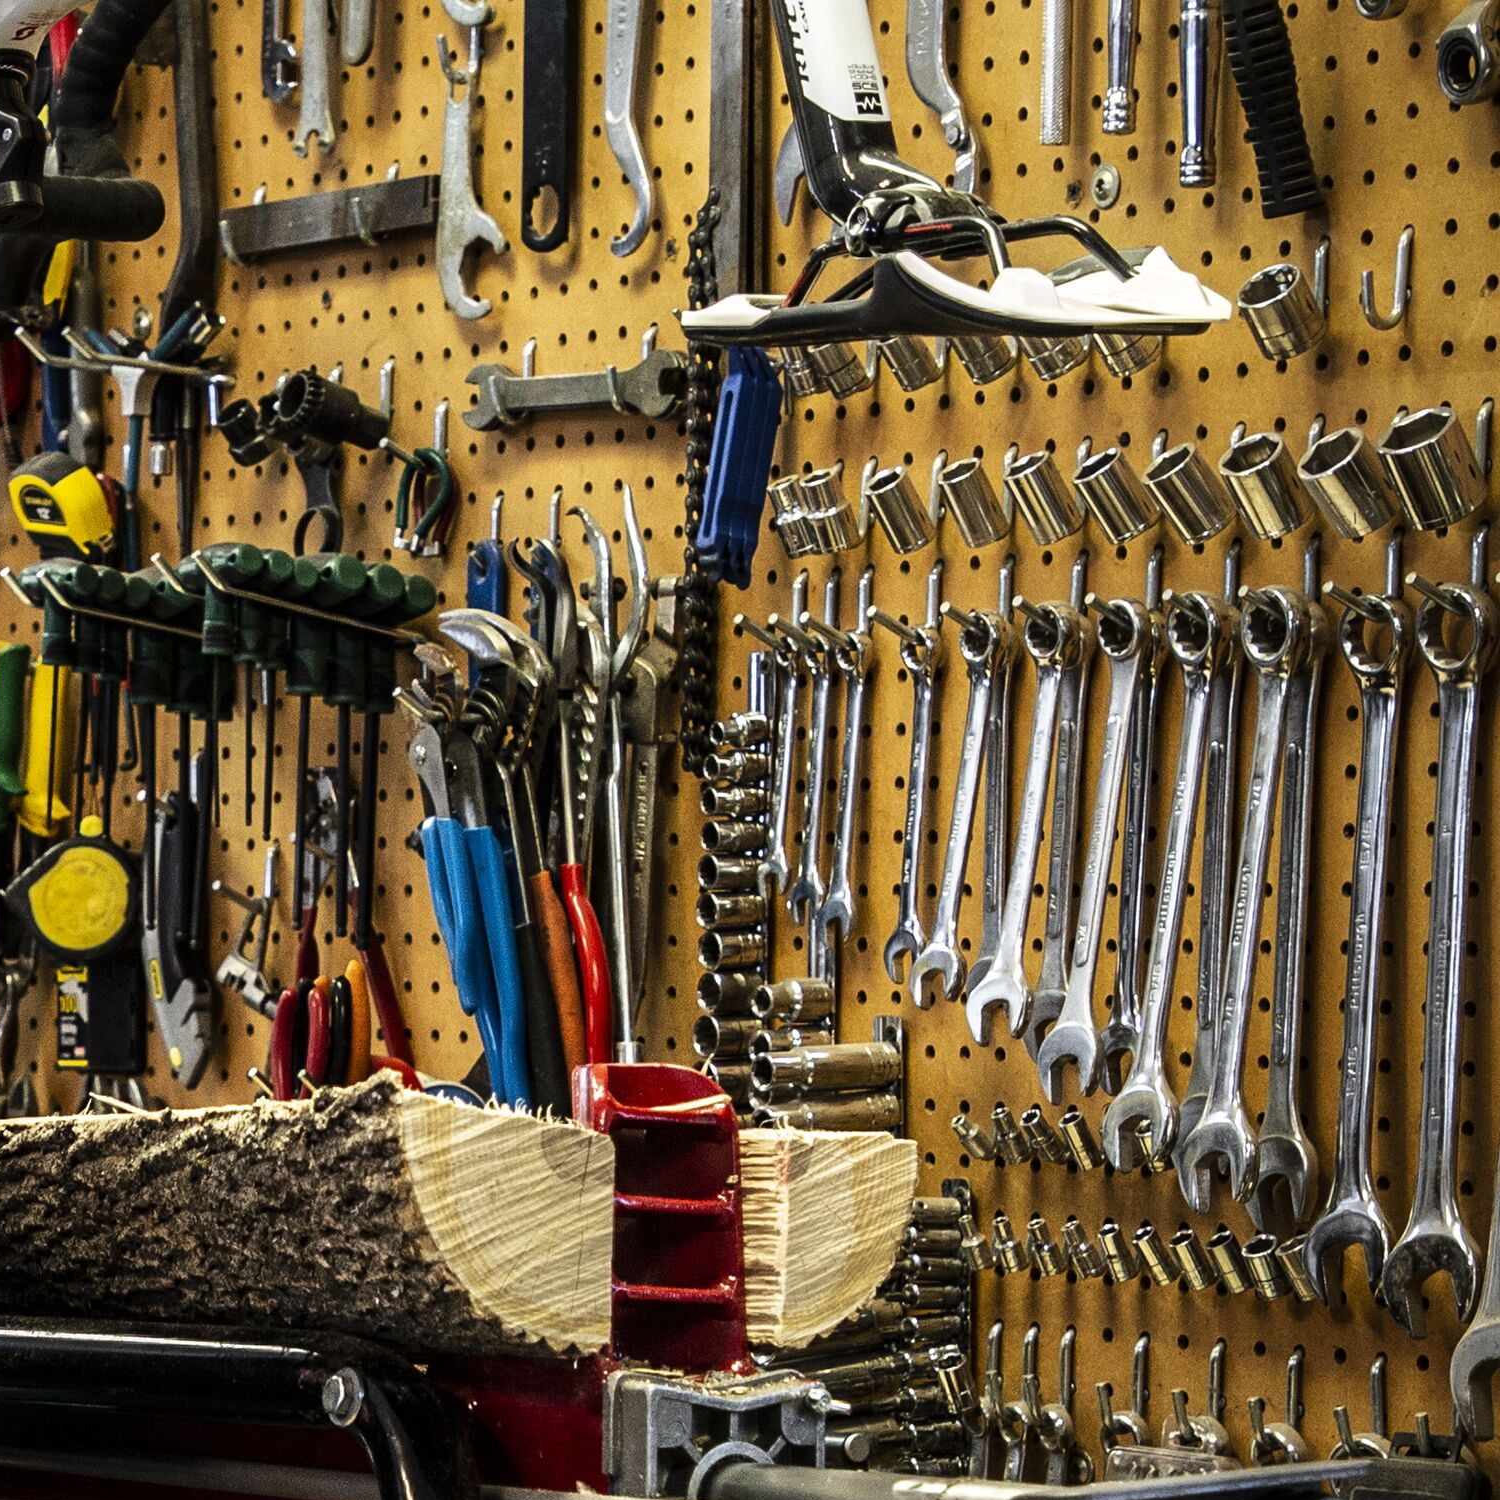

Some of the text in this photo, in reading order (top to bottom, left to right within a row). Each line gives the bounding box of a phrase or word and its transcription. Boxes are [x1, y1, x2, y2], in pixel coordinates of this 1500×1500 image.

[1158, 850, 1178, 933] Pittsburgh
[1232, 863, 1253, 946] Pittsburgh
[1345, 818, 1373, 1098] 15/16 Pittsburgh 15/16
[1433, 928, 1451, 1025] Pittsburgh
